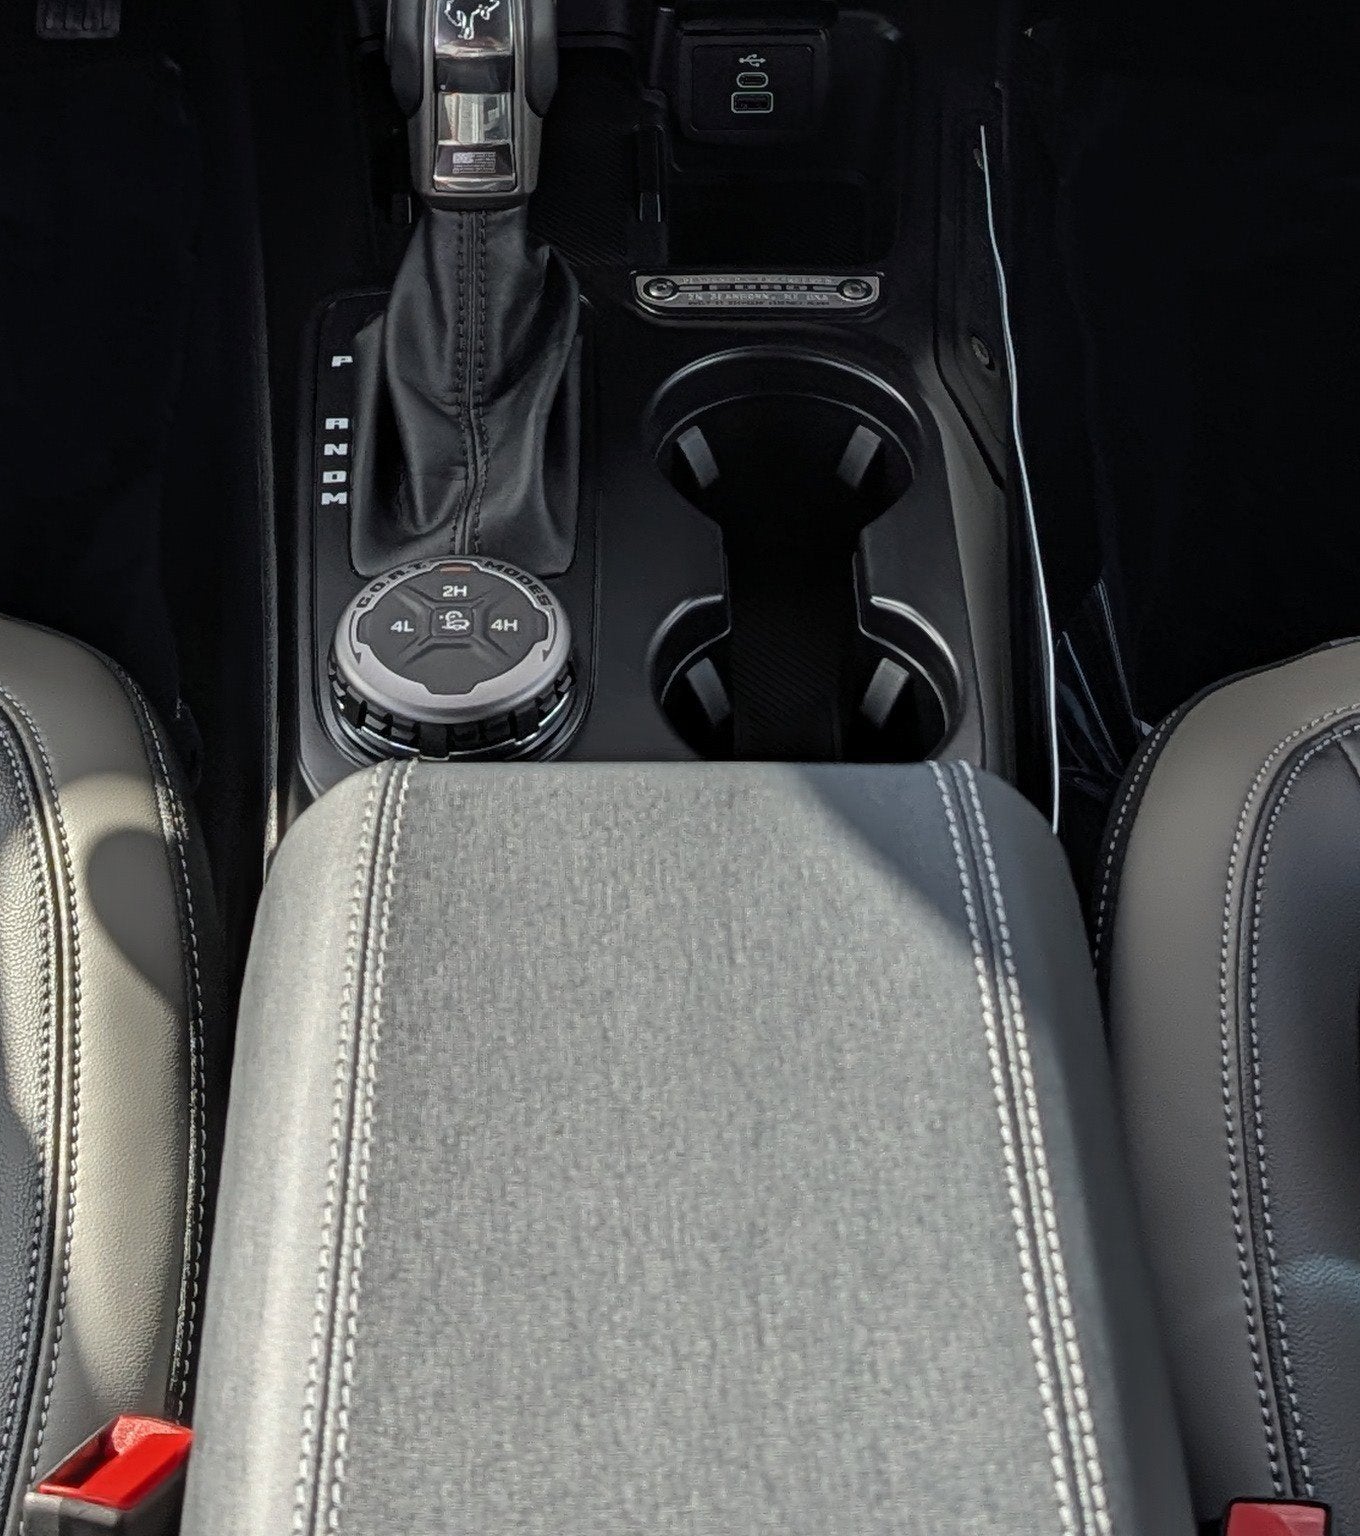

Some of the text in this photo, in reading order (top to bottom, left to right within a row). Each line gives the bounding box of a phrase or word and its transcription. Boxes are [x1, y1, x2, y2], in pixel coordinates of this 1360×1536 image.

[331, 355, 354, 368] P
[324, 443, 348, 456] N
[322, 470, 347, 484] D
[321, 491, 348, 505] M
[484, 560, 552, 607] MODES
[442, 585, 468, 598] 2H
[390, 620, 415, 633] 4L
[490, 618, 519, 632] 4H
